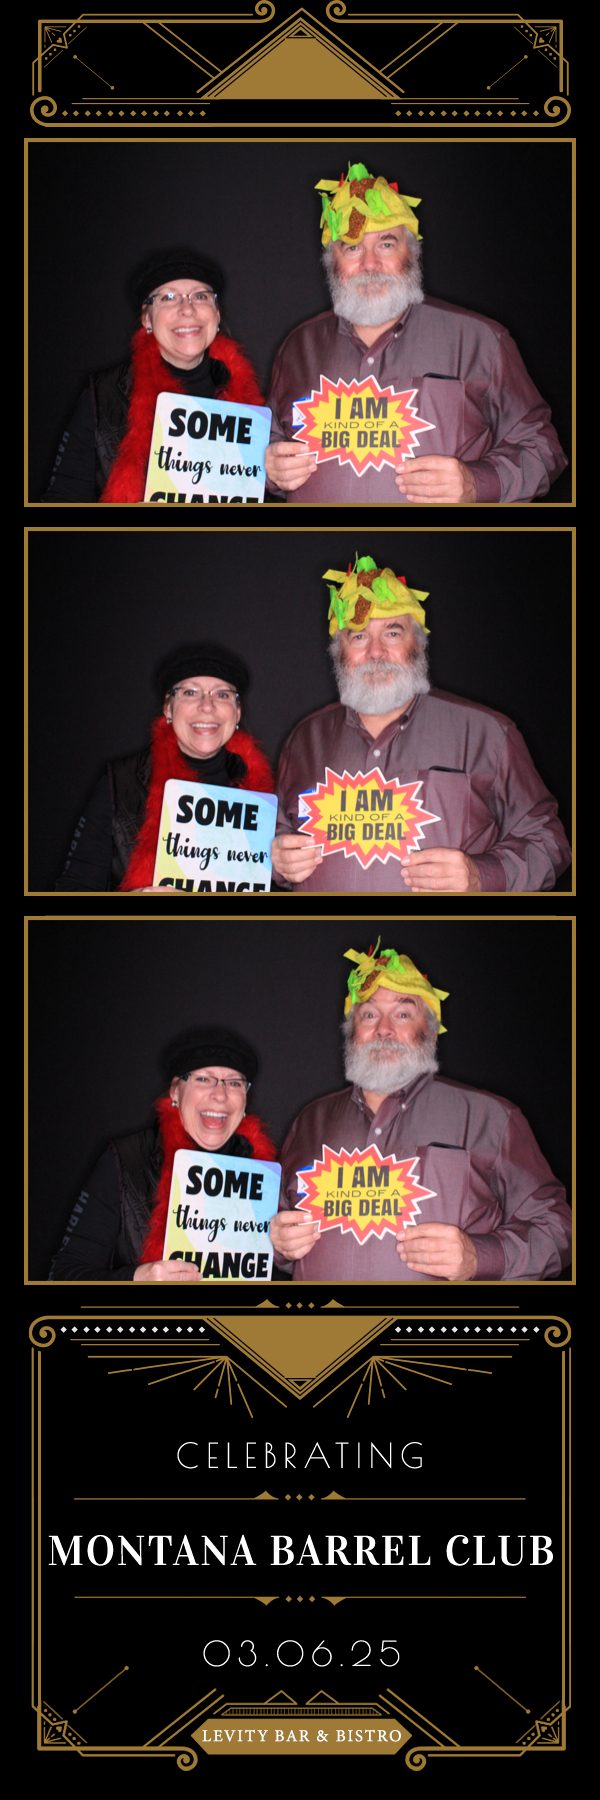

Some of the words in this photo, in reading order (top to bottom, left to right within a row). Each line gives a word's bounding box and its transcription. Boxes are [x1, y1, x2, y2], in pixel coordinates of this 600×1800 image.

[334, 397, 342, 420] I
[349, 396, 388, 420] AM
[168, 407, 253, 445] SOME
[323, 420, 360, 430] KIND
[364, 420, 385, 429] OF
[388, 420, 400, 429] A
[321, 430, 350, 449] BIG
[356, 430, 402, 449] DEAL
[154, 446, 213, 485] things
[219, 463, 262, 478] never
[176, 794, 259, 831] SOME
[340, 789, 347, 813] I
[354, 788, 393, 812] AM
[329, 813, 365, 822] KIND
[369, 812, 391, 821] OF
[394, 812, 405, 821] A
[327, 823, 356, 841] BIG
[362, 822, 407, 841] DEAL
[162, 831, 220, 871] things
[227, 849, 268, 864] never
[185, 1165, 264, 1201] SOME
[337, 1166, 344, 1189] I
[351, 1164, 390, 1188] AM
[326, 1189, 362, 1199] KIND
[366, 1188, 387, 1198] OF
[390, 1188, 401, 1197] A
[323, 1199, 352, 1217] BIG
[358, 1198, 403, 1217] DEAL
[172, 1204, 227, 1243] things
[233, 1220, 271, 1233] never
